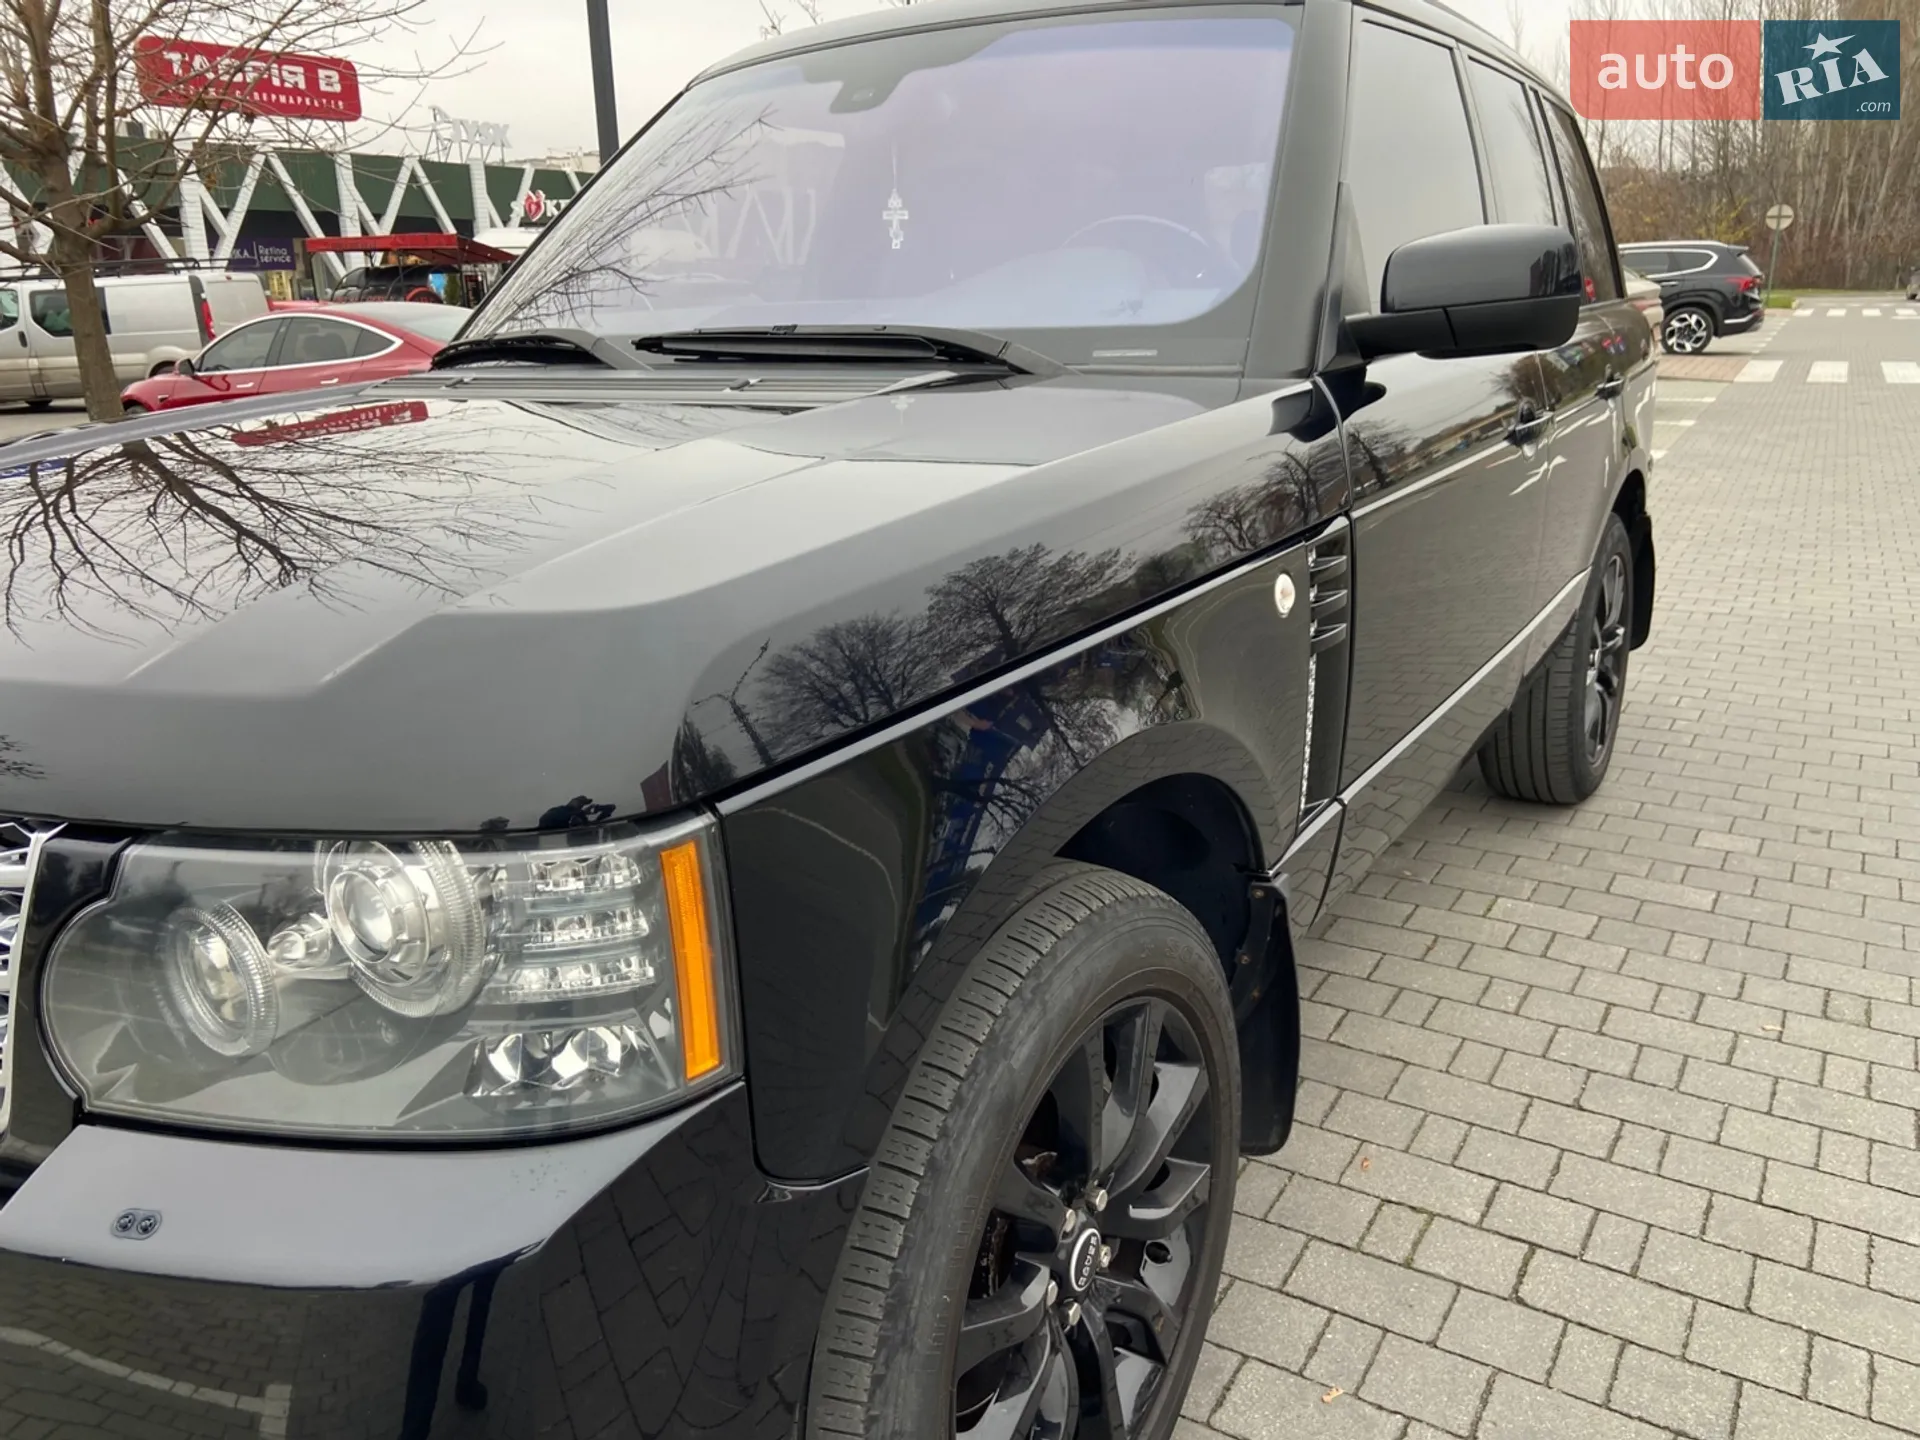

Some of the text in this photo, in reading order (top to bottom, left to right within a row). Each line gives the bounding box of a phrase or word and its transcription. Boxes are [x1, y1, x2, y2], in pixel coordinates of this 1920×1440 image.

[318, 67, 342, 93] В
[258, 244, 288, 255] Retina
[259, 254, 292, 263] service
